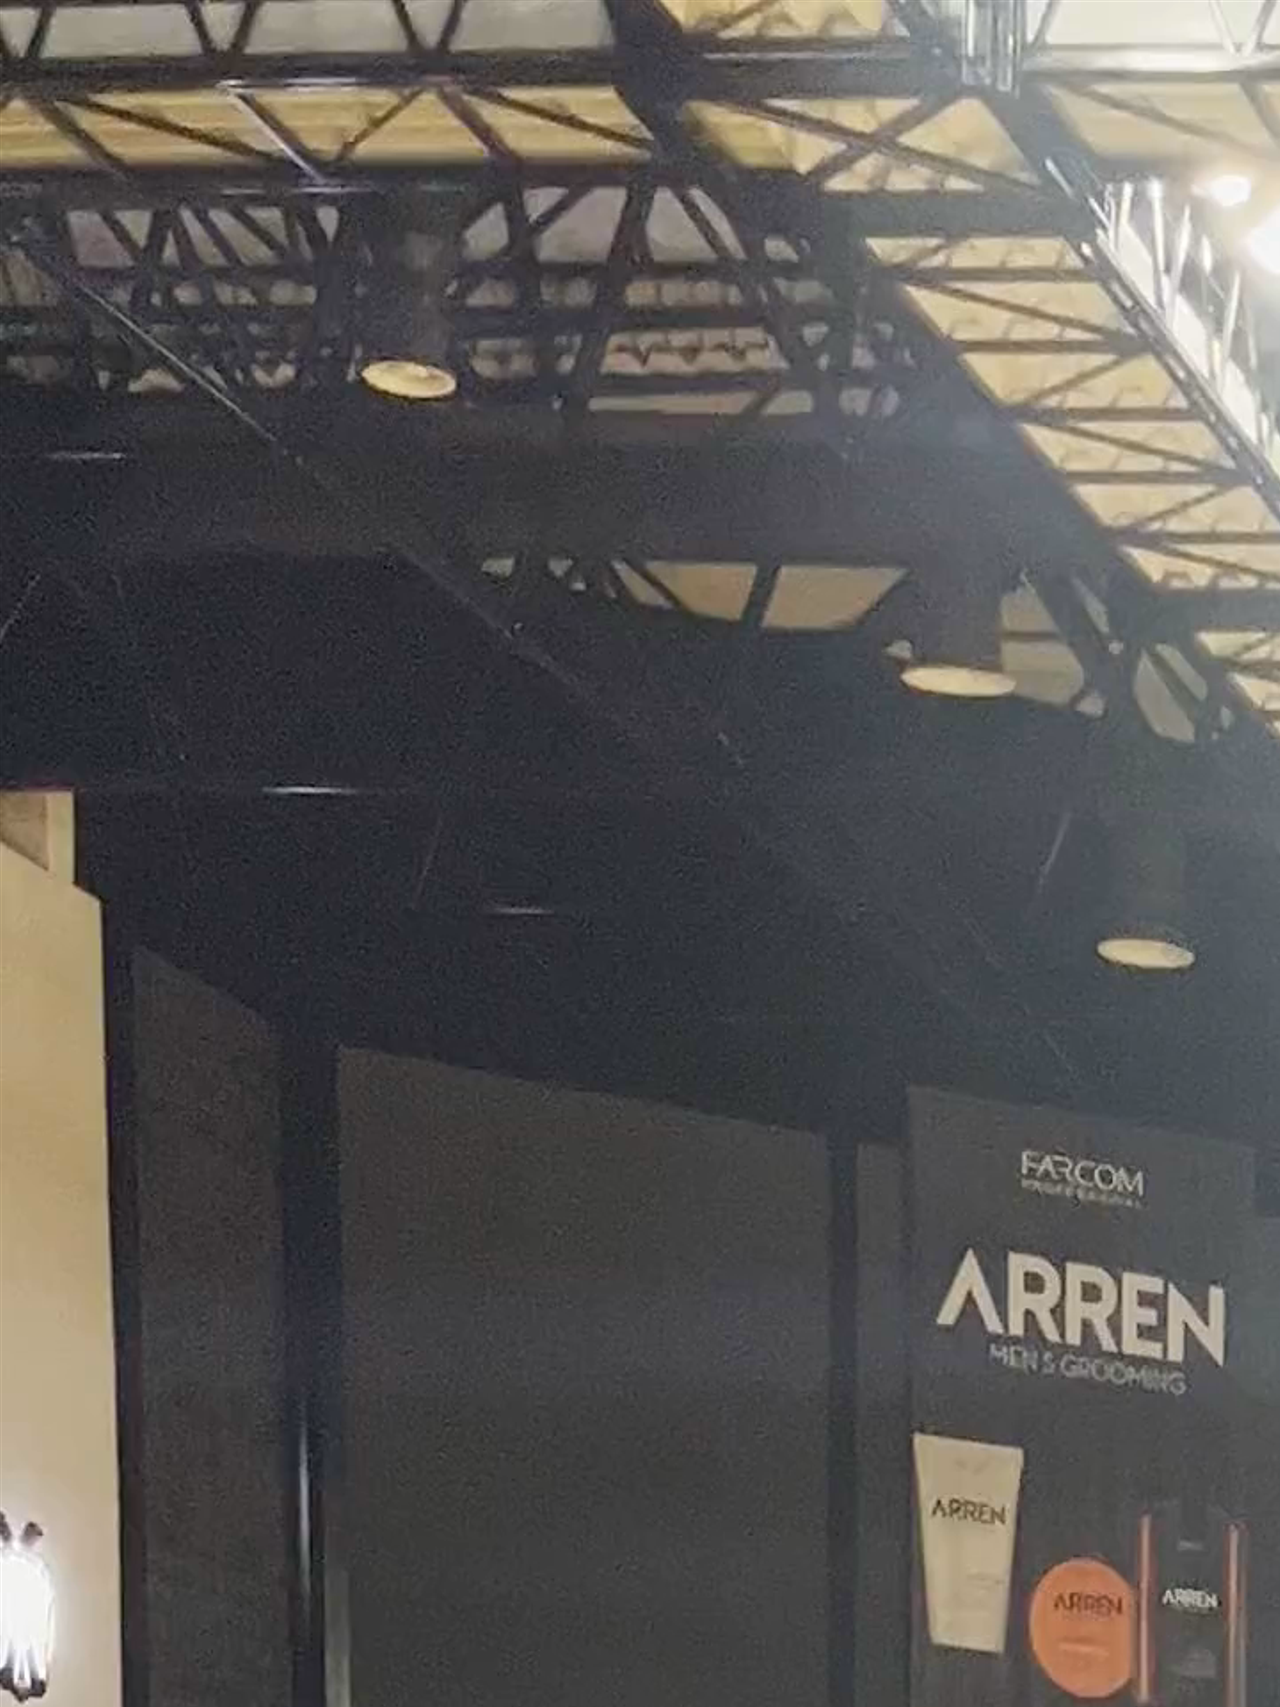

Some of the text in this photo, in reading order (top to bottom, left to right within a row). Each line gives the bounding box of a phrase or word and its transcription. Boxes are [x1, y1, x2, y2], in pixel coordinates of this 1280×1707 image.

[1021, 1150, 1144, 1196] FARCOM
[936, 1247, 1226, 1368] ARREN
[931, 1498, 1007, 1525] ARREN
[1053, 1592, 1124, 1615] ARREN
[1161, 1587, 1220, 1609] ARREN
